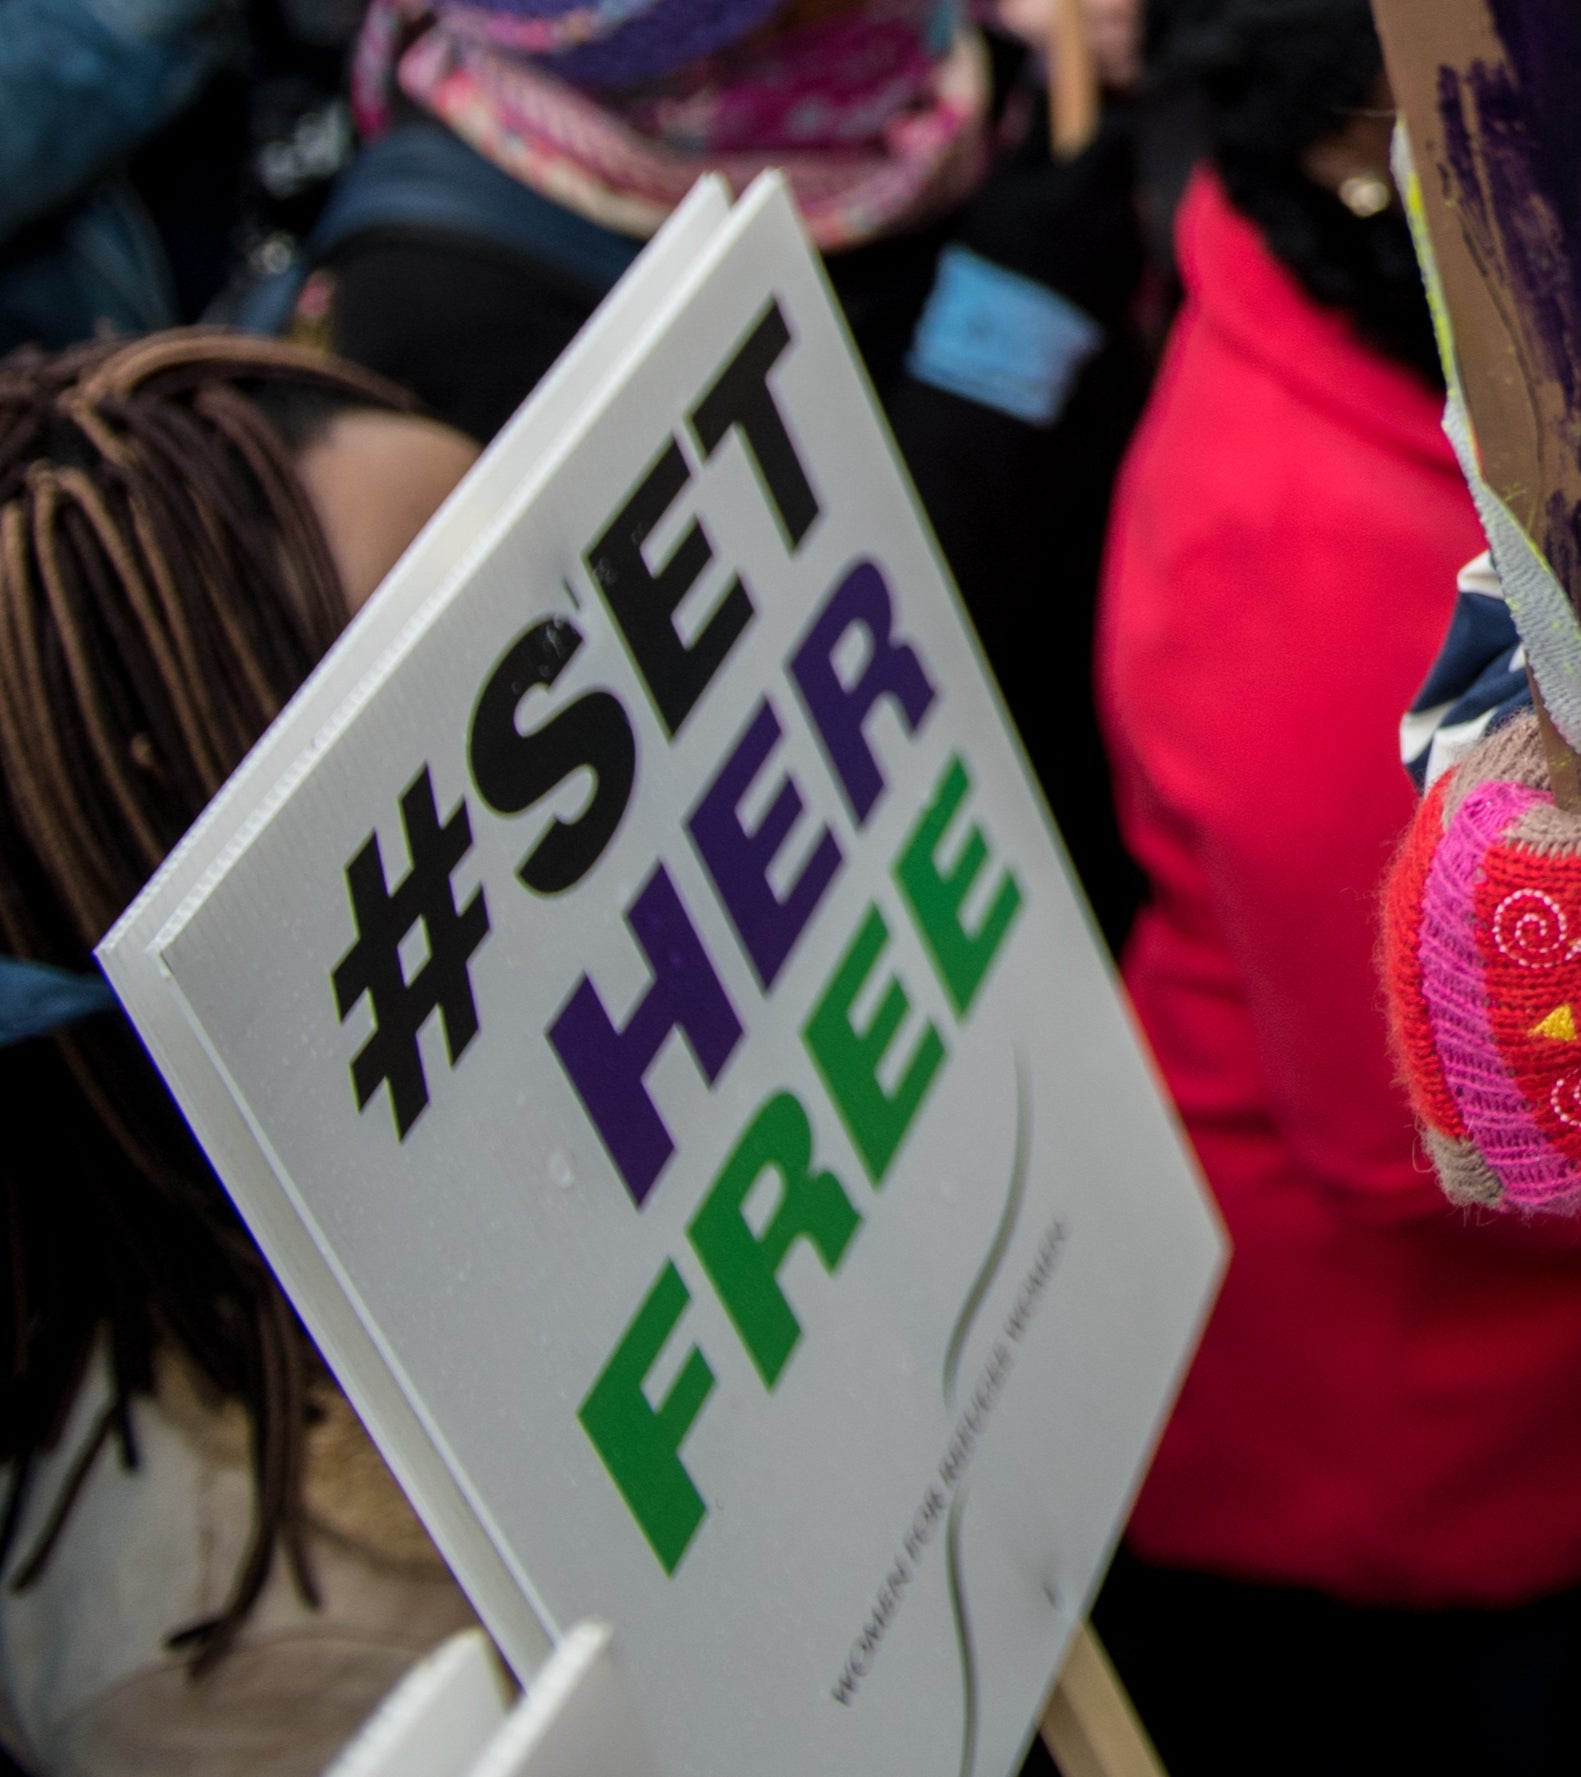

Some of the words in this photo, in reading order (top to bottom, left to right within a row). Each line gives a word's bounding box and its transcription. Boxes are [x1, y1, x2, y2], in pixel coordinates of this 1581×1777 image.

[330, 292, 822, 1145] #SET
[544, 554, 940, 1212] HER
[576, 751, 1026, 1580] FREE
